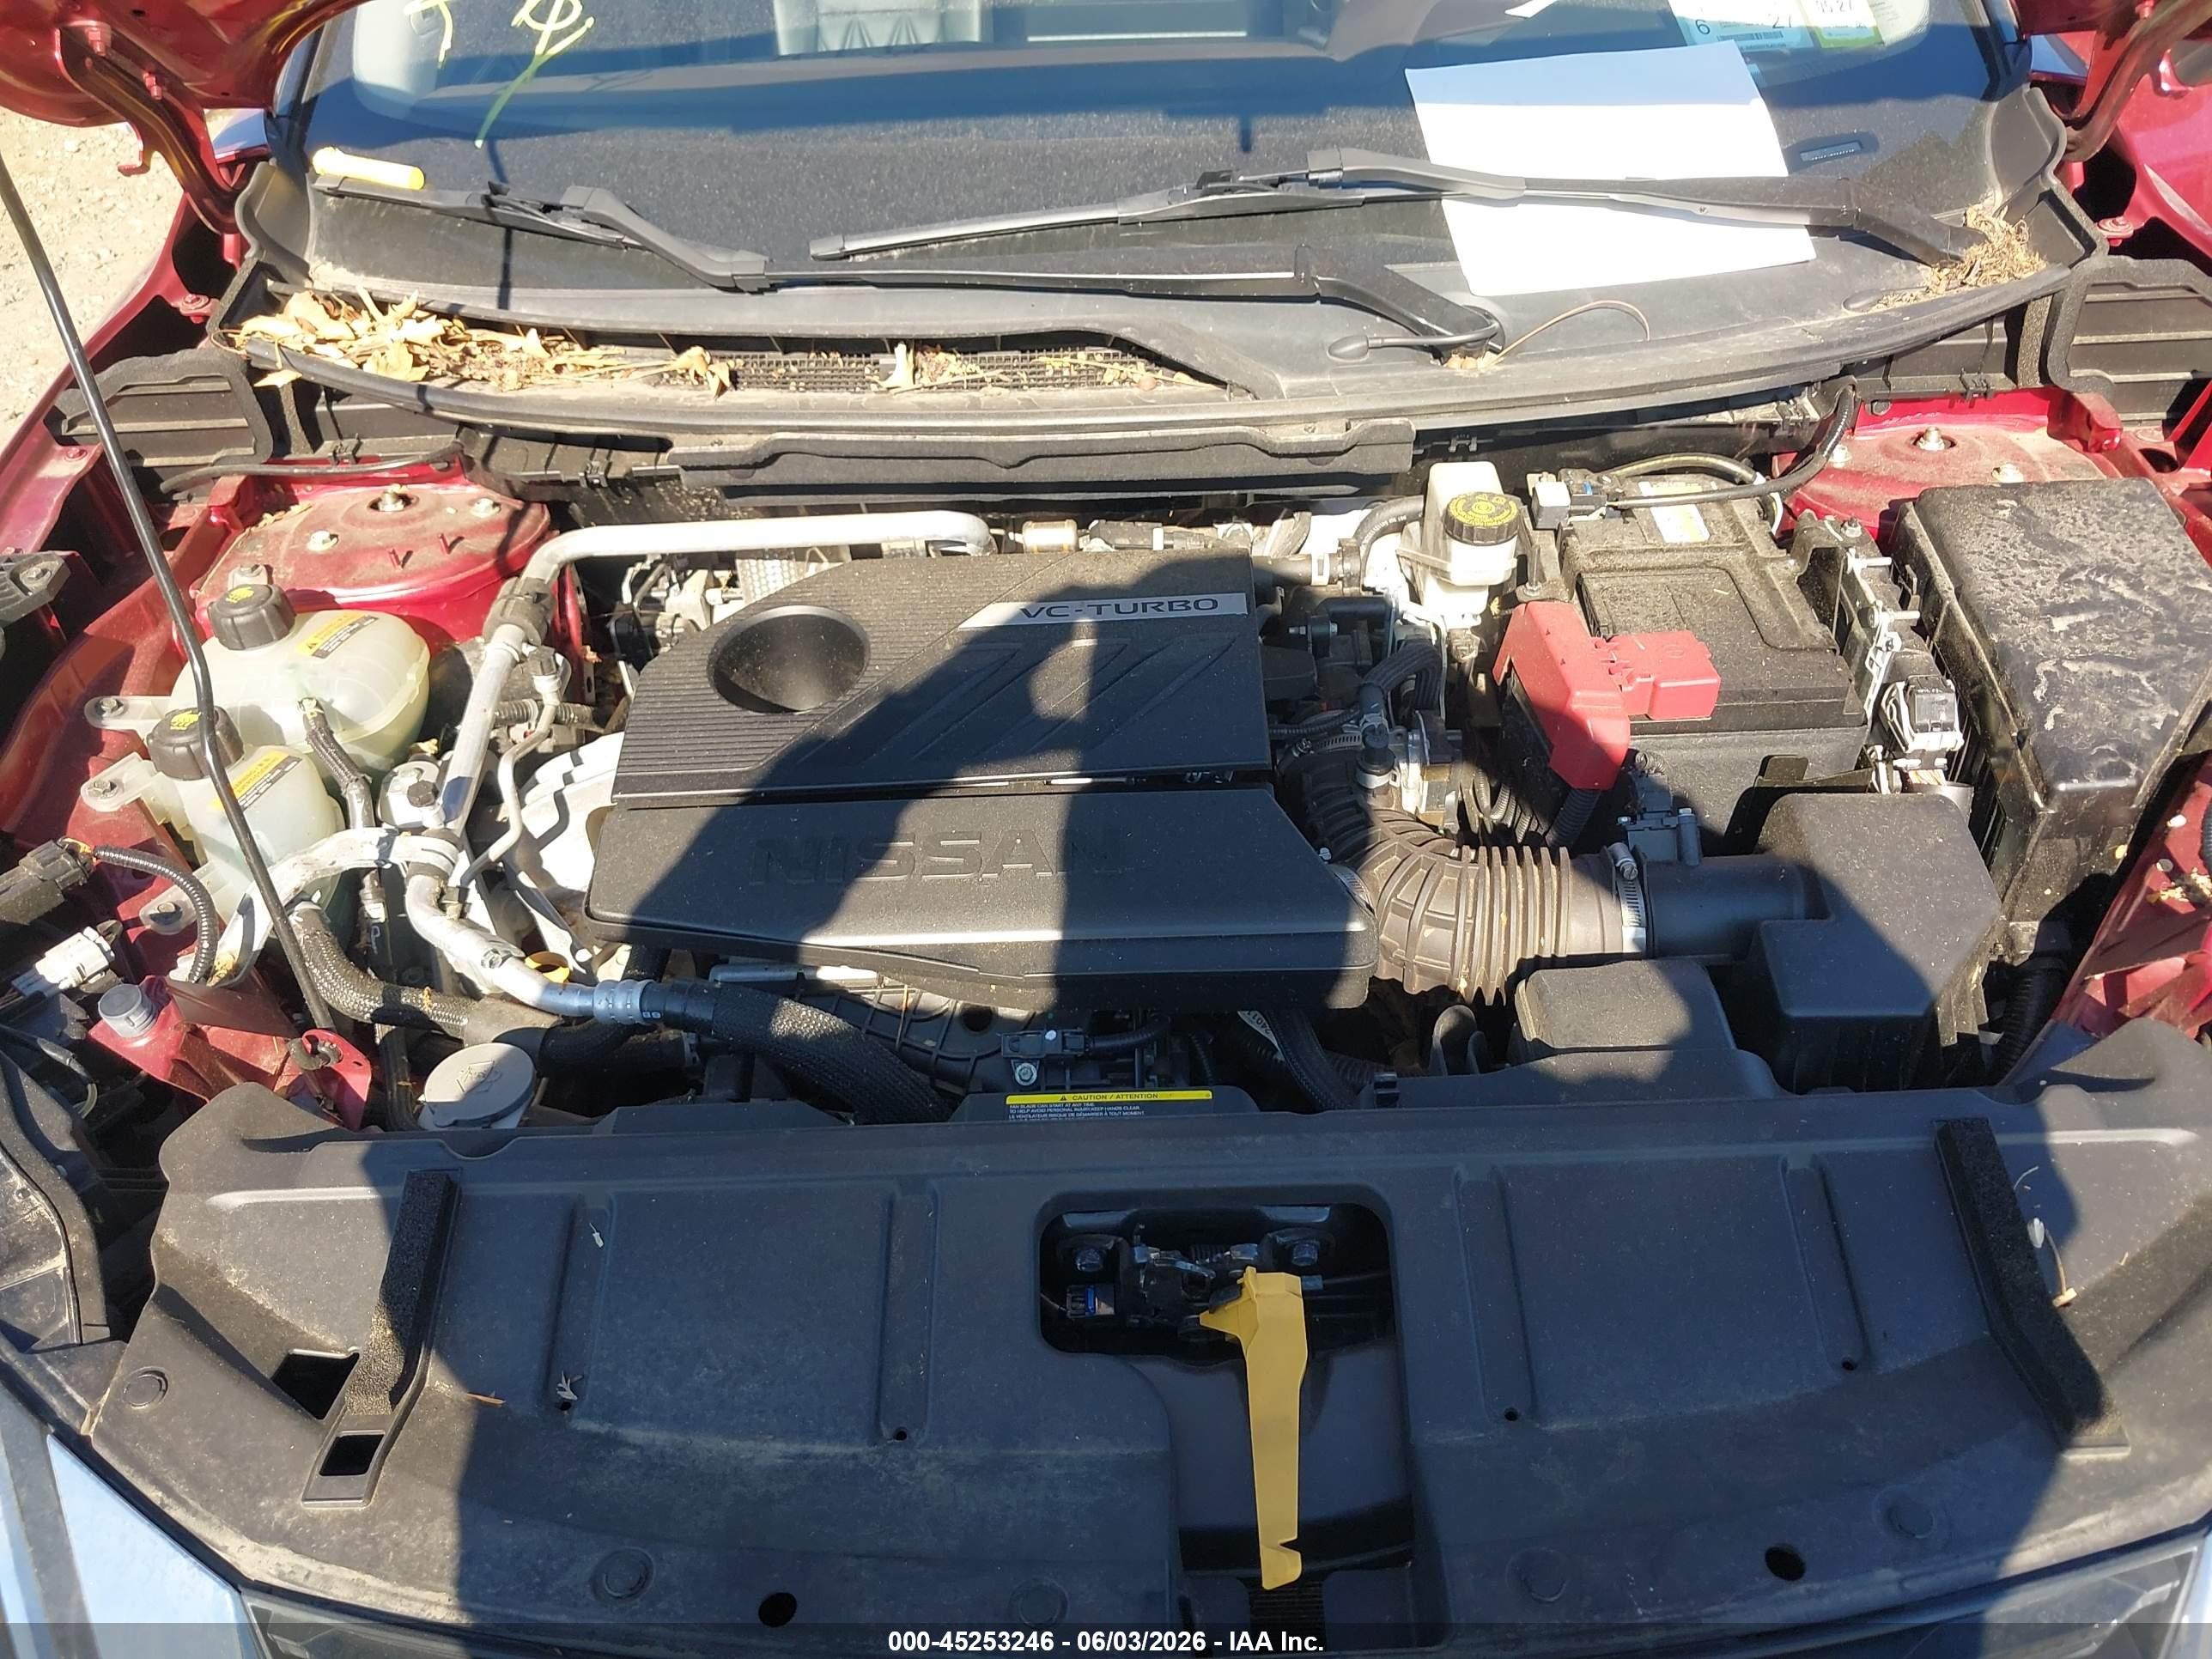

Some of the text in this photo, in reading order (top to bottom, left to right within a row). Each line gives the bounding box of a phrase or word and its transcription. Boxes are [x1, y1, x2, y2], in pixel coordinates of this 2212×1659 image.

[1695, 19, 1711, 35] 6
[1020, 598, 1219, 619] VC-TURBO
[748, 830, 1134, 885] NISSAN
